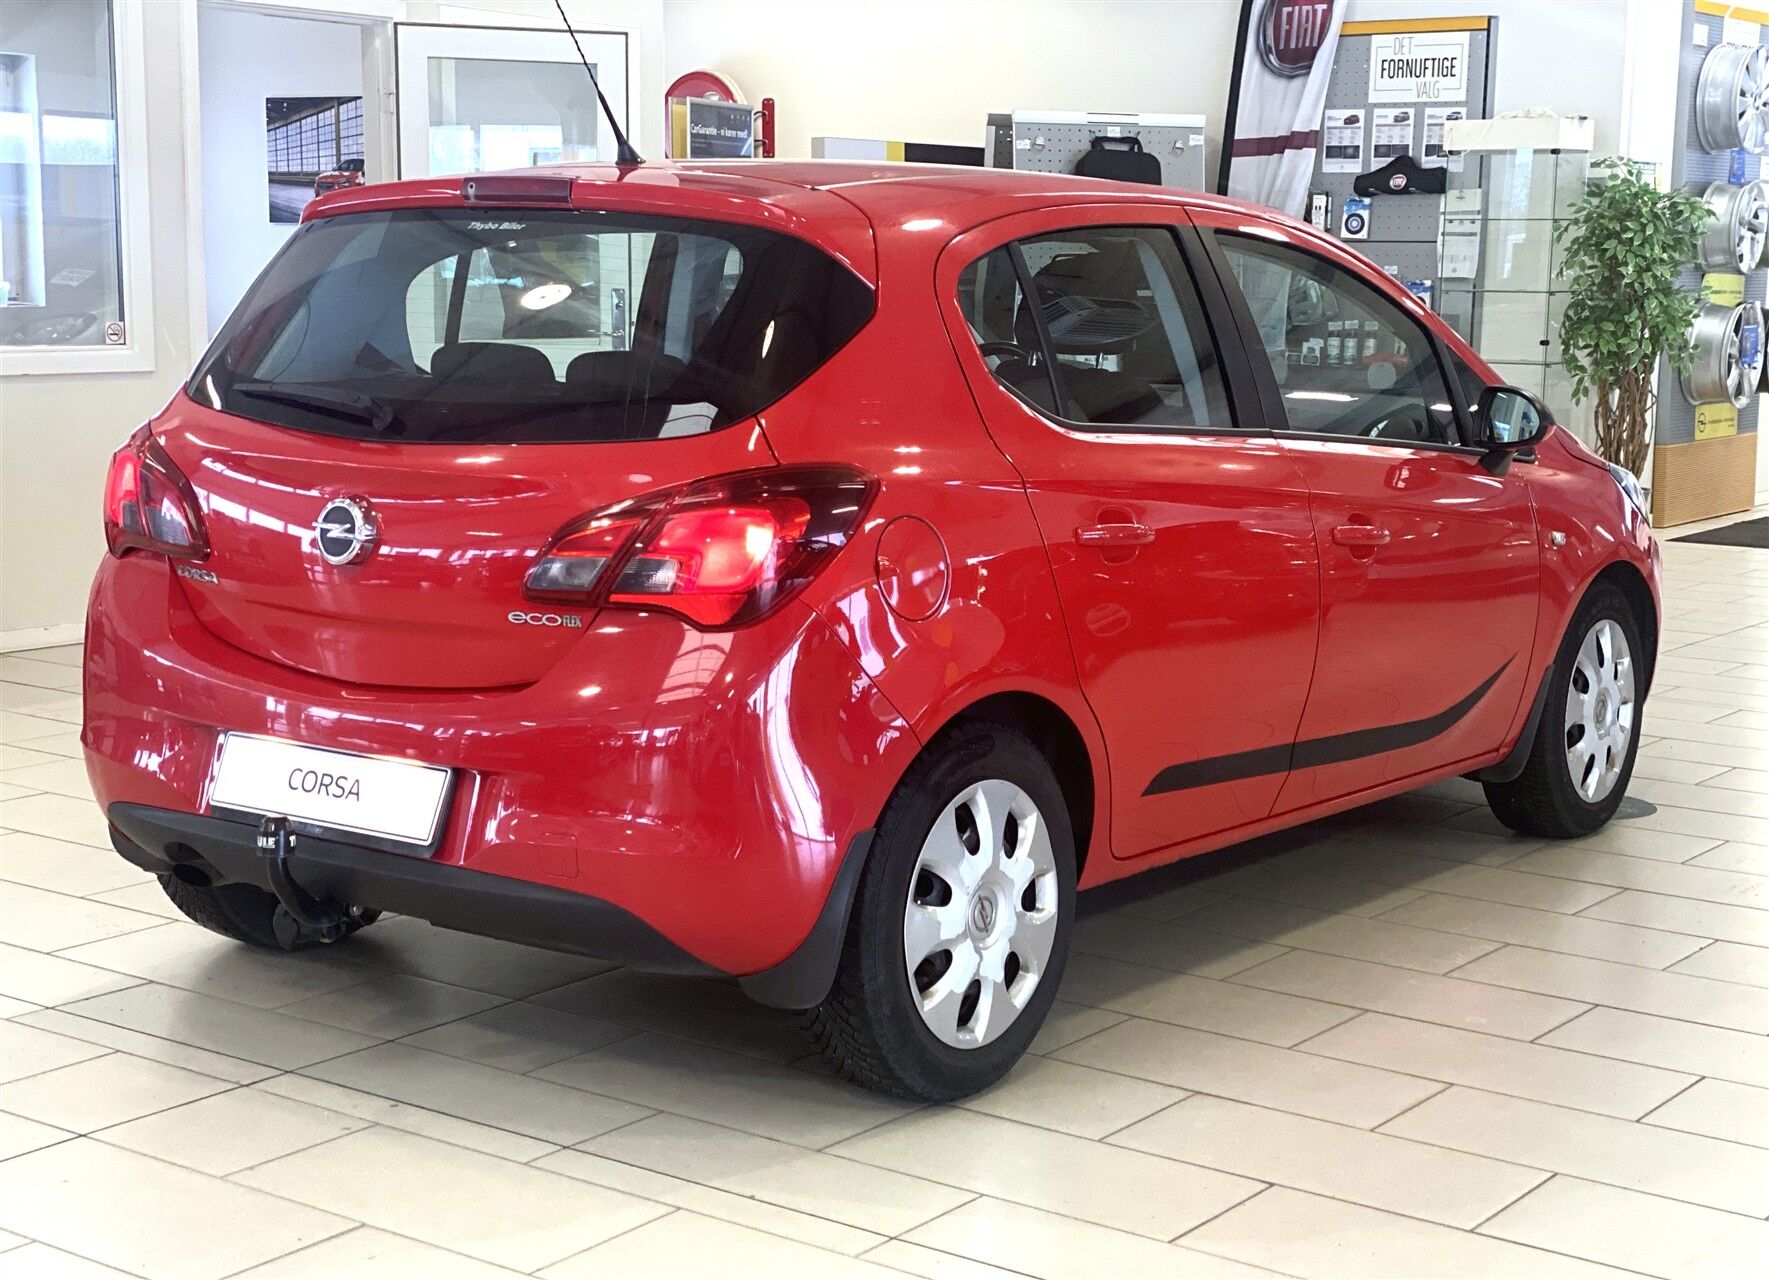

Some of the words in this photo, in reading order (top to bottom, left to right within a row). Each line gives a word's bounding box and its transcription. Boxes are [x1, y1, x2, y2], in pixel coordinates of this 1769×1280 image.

[1279, 4, 1328, 49] FIAT
[1393, 36, 1415, 55] DET
[1380, 57, 1458, 79] FORNUFTIGE
[1415, 80, 1441, 99] VALG
[467, 221, 499, 231] Thybo
[498, 221, 527, 231] Biler
[507, 611, 582, 628] ecoFLEX
[288, 767, 360, 803] CORSA
[257, 835, 276, 849] ULE
